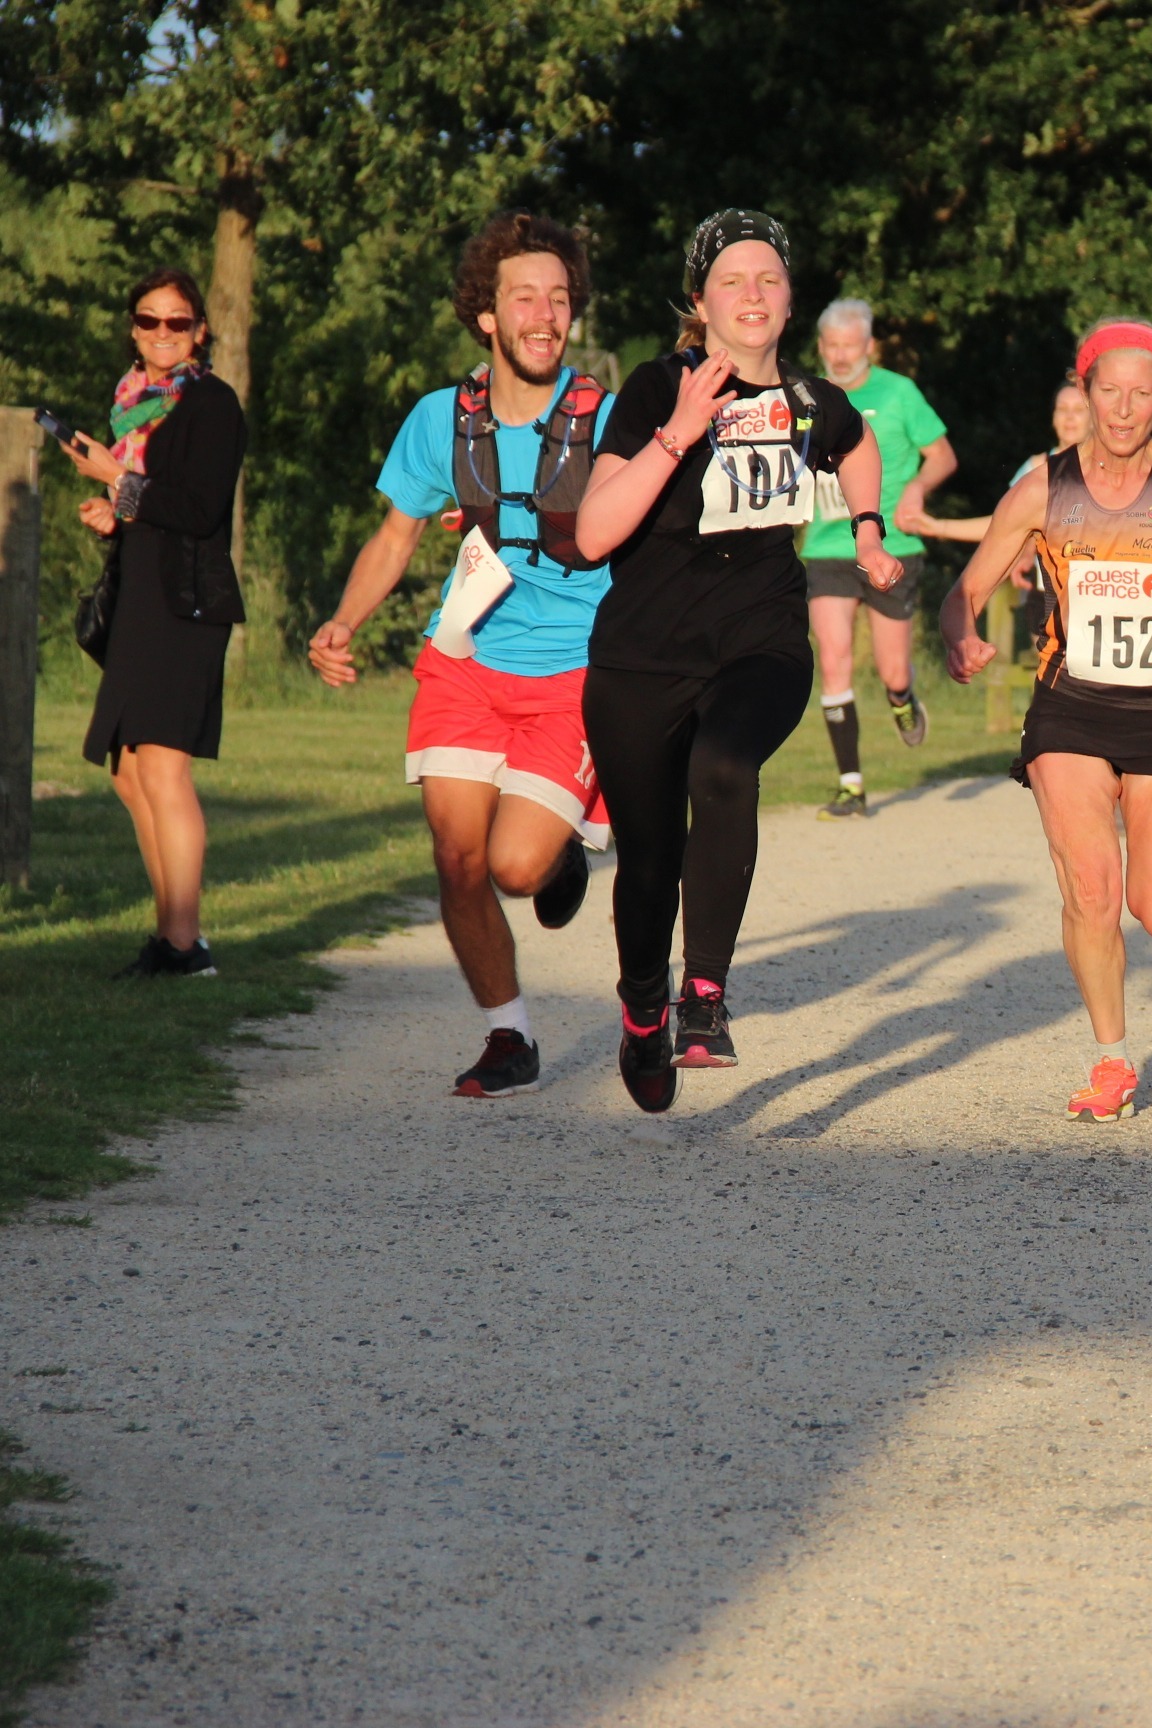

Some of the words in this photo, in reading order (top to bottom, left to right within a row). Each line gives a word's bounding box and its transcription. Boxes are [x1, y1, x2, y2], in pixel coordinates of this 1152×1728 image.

[716, 418, 766, 438] ance
[725, 448, 800, 513] 104
[1062, 516, 1084, 525] START
[1084, 568, 1140, 585] ouest
[1077, 580, 1140, 600] france
